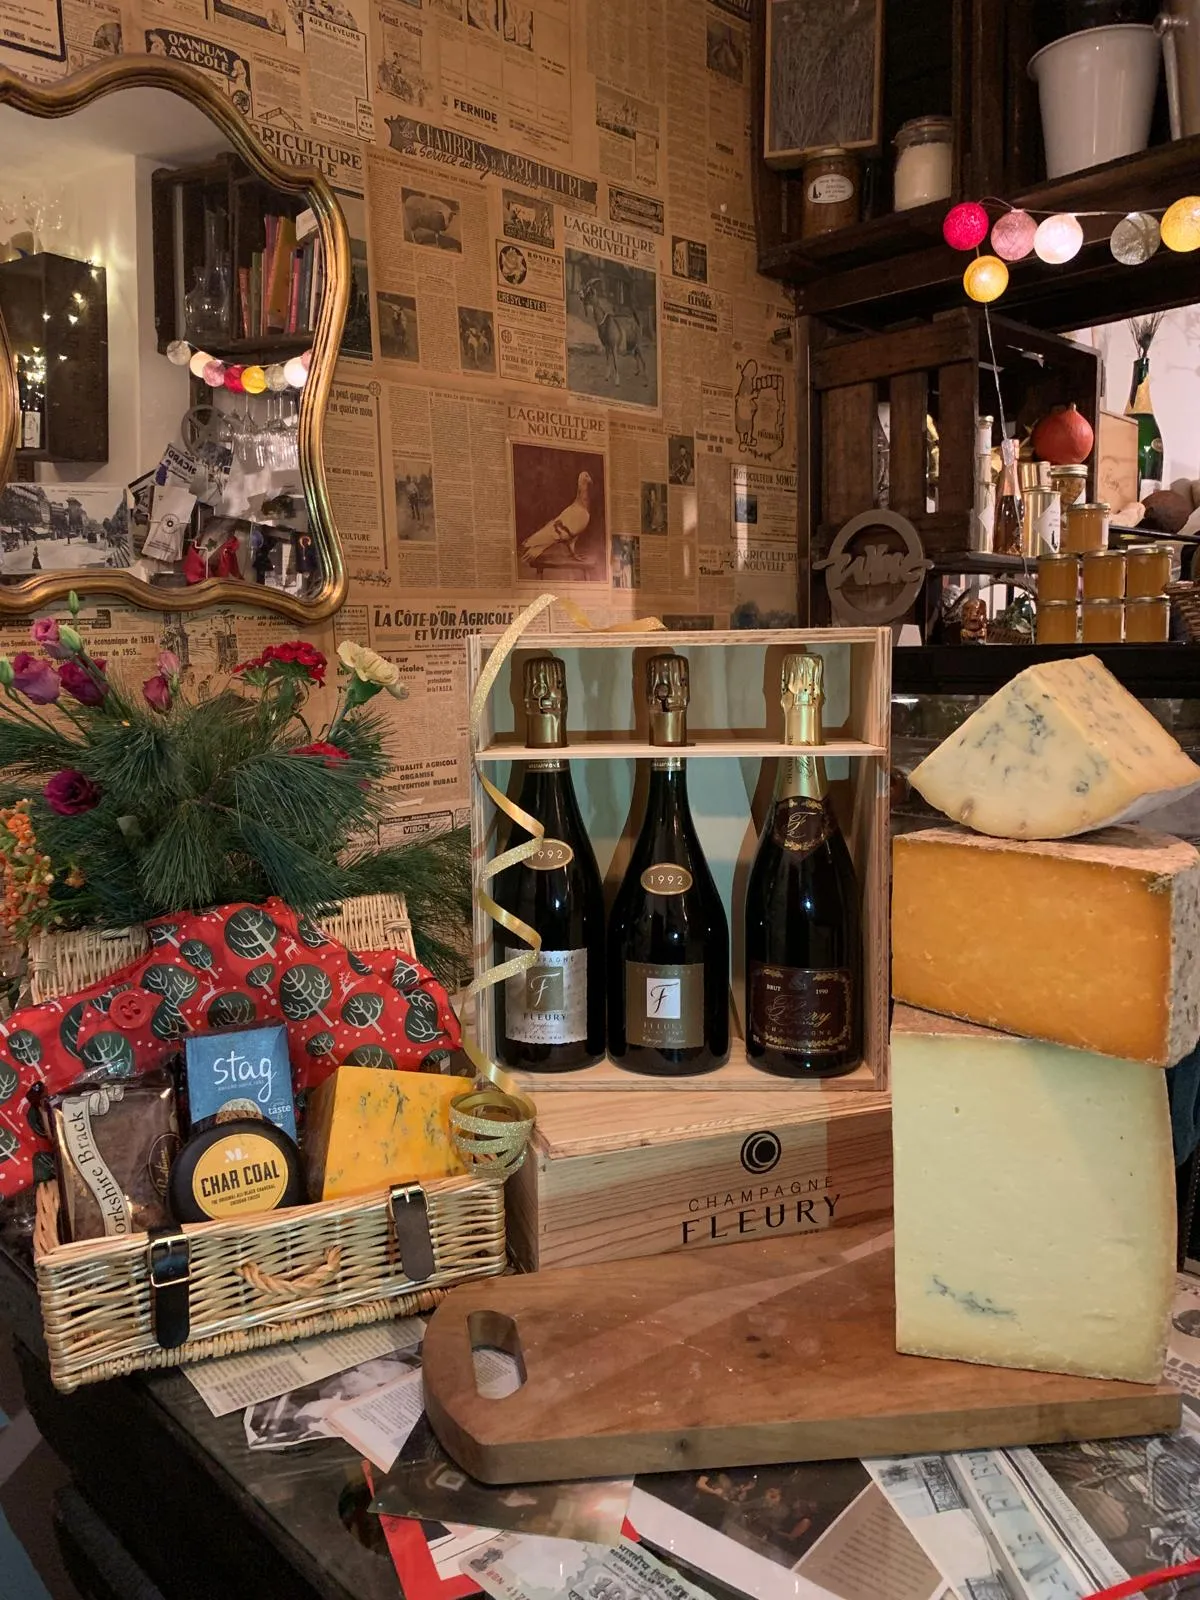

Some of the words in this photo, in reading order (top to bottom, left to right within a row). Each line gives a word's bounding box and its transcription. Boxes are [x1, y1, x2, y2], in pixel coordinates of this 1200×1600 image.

[308, 16, 323, 27] AUX
[168, 33, 228, 62] OMNIUM
[168, 46, 230, 76] AVICOLE
[454, 97, 498, 125] FERNIDE
[251, 123, 363, 170] GRICULTURE
[416, 123, 488, 166] CHAMBRES
[263, 143, 339, 178] OUVELLE
[563, 215, 656, 254] L'AGRICULTURE
[582, 234, 639, 262] NOUVELLE
[507, 406, 606, 432] L'AGRICULTURE
[527, 422, 589, 442] NOUVELLE
[374, 609, 392, 627] LA
[459, 611, 514, 627] AGRICOLE
[415, 629, 428, 642] ET
[395, 656, 409, 664] sur
[399, 770, 434, 782] ORGANISE
[425, 758, 458, 769] AGRICOLE
[432, 776, 458, 788] RURALE
[649, 874, 684, 886] 1992
[538, 955, 575, 963] PAGNE
[766, 983, 782, 992] BRUT
[523, 1012, 567, 1021] FLEURY
[213, 1050, 278, 1103] stag
[268, 1104, 292, 1115] taste
[69, 1110, 96, 1165] Brack
[200, 1169, 241, 1198] CHAR
[242, 1159, 281, 1186] COAL
[92, 1167, 127, 1234] orkshire
[688, 1175, 834, 1213] CHAMPAGNE
[682, 1193, 841, 1244] FLEURY
